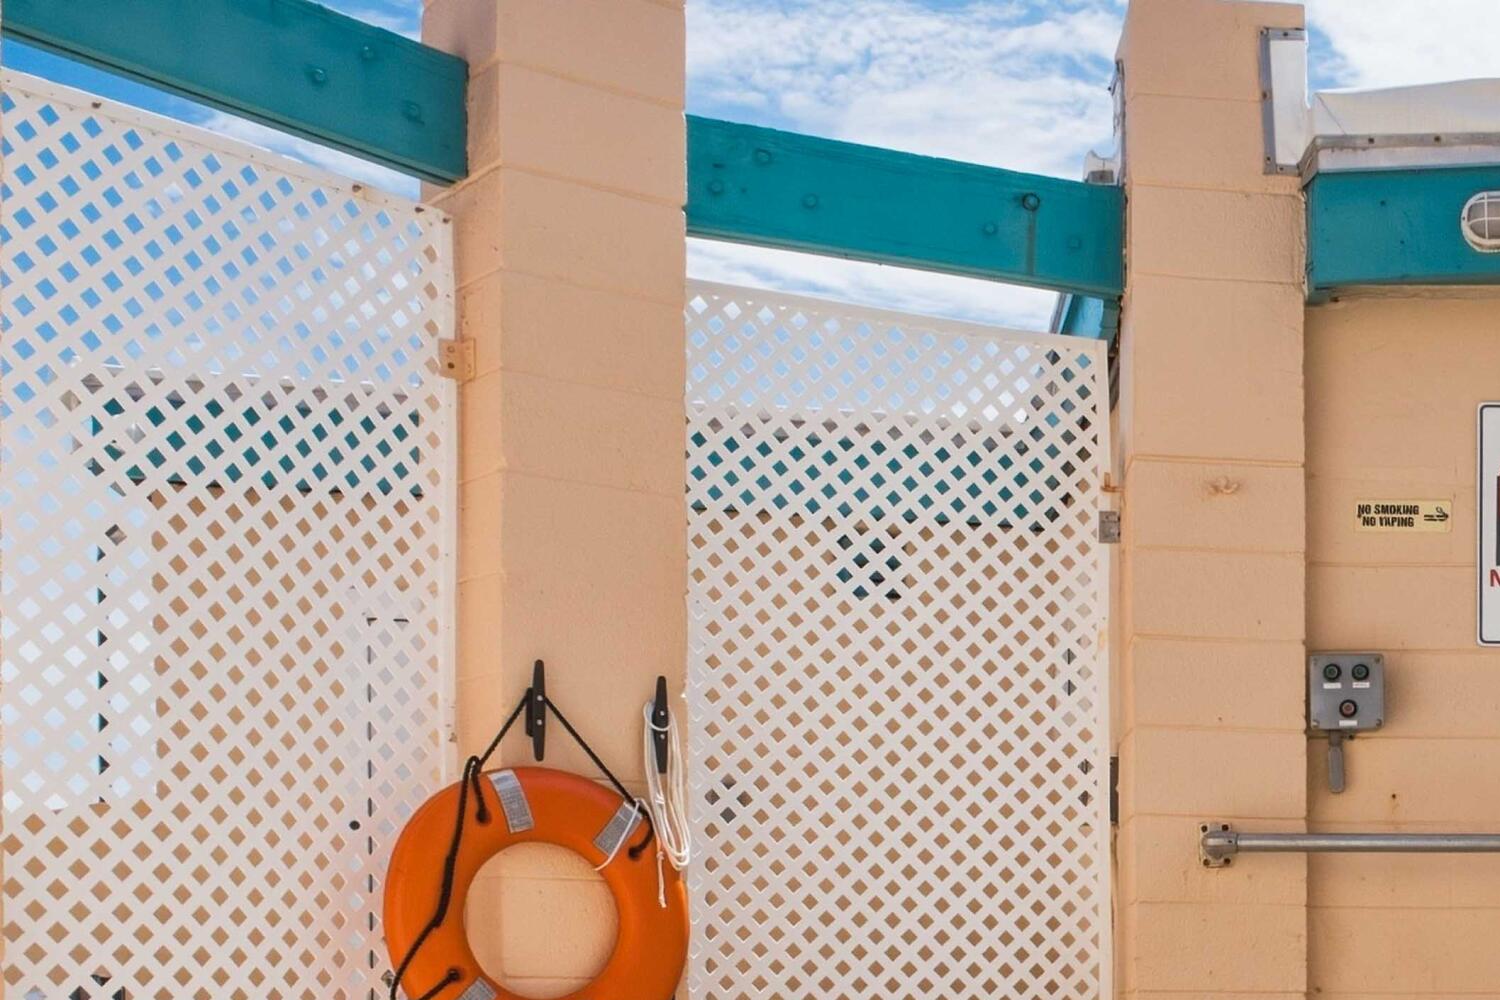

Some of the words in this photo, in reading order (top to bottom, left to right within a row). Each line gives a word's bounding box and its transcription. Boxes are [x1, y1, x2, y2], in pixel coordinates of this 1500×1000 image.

[1358, 504, 1371, 514] NO
[1374, 504, 1419, 515] SMOKING
[1362, 517, 1376, 526] NO
[1380, 517, 1414, 527] VAPING
